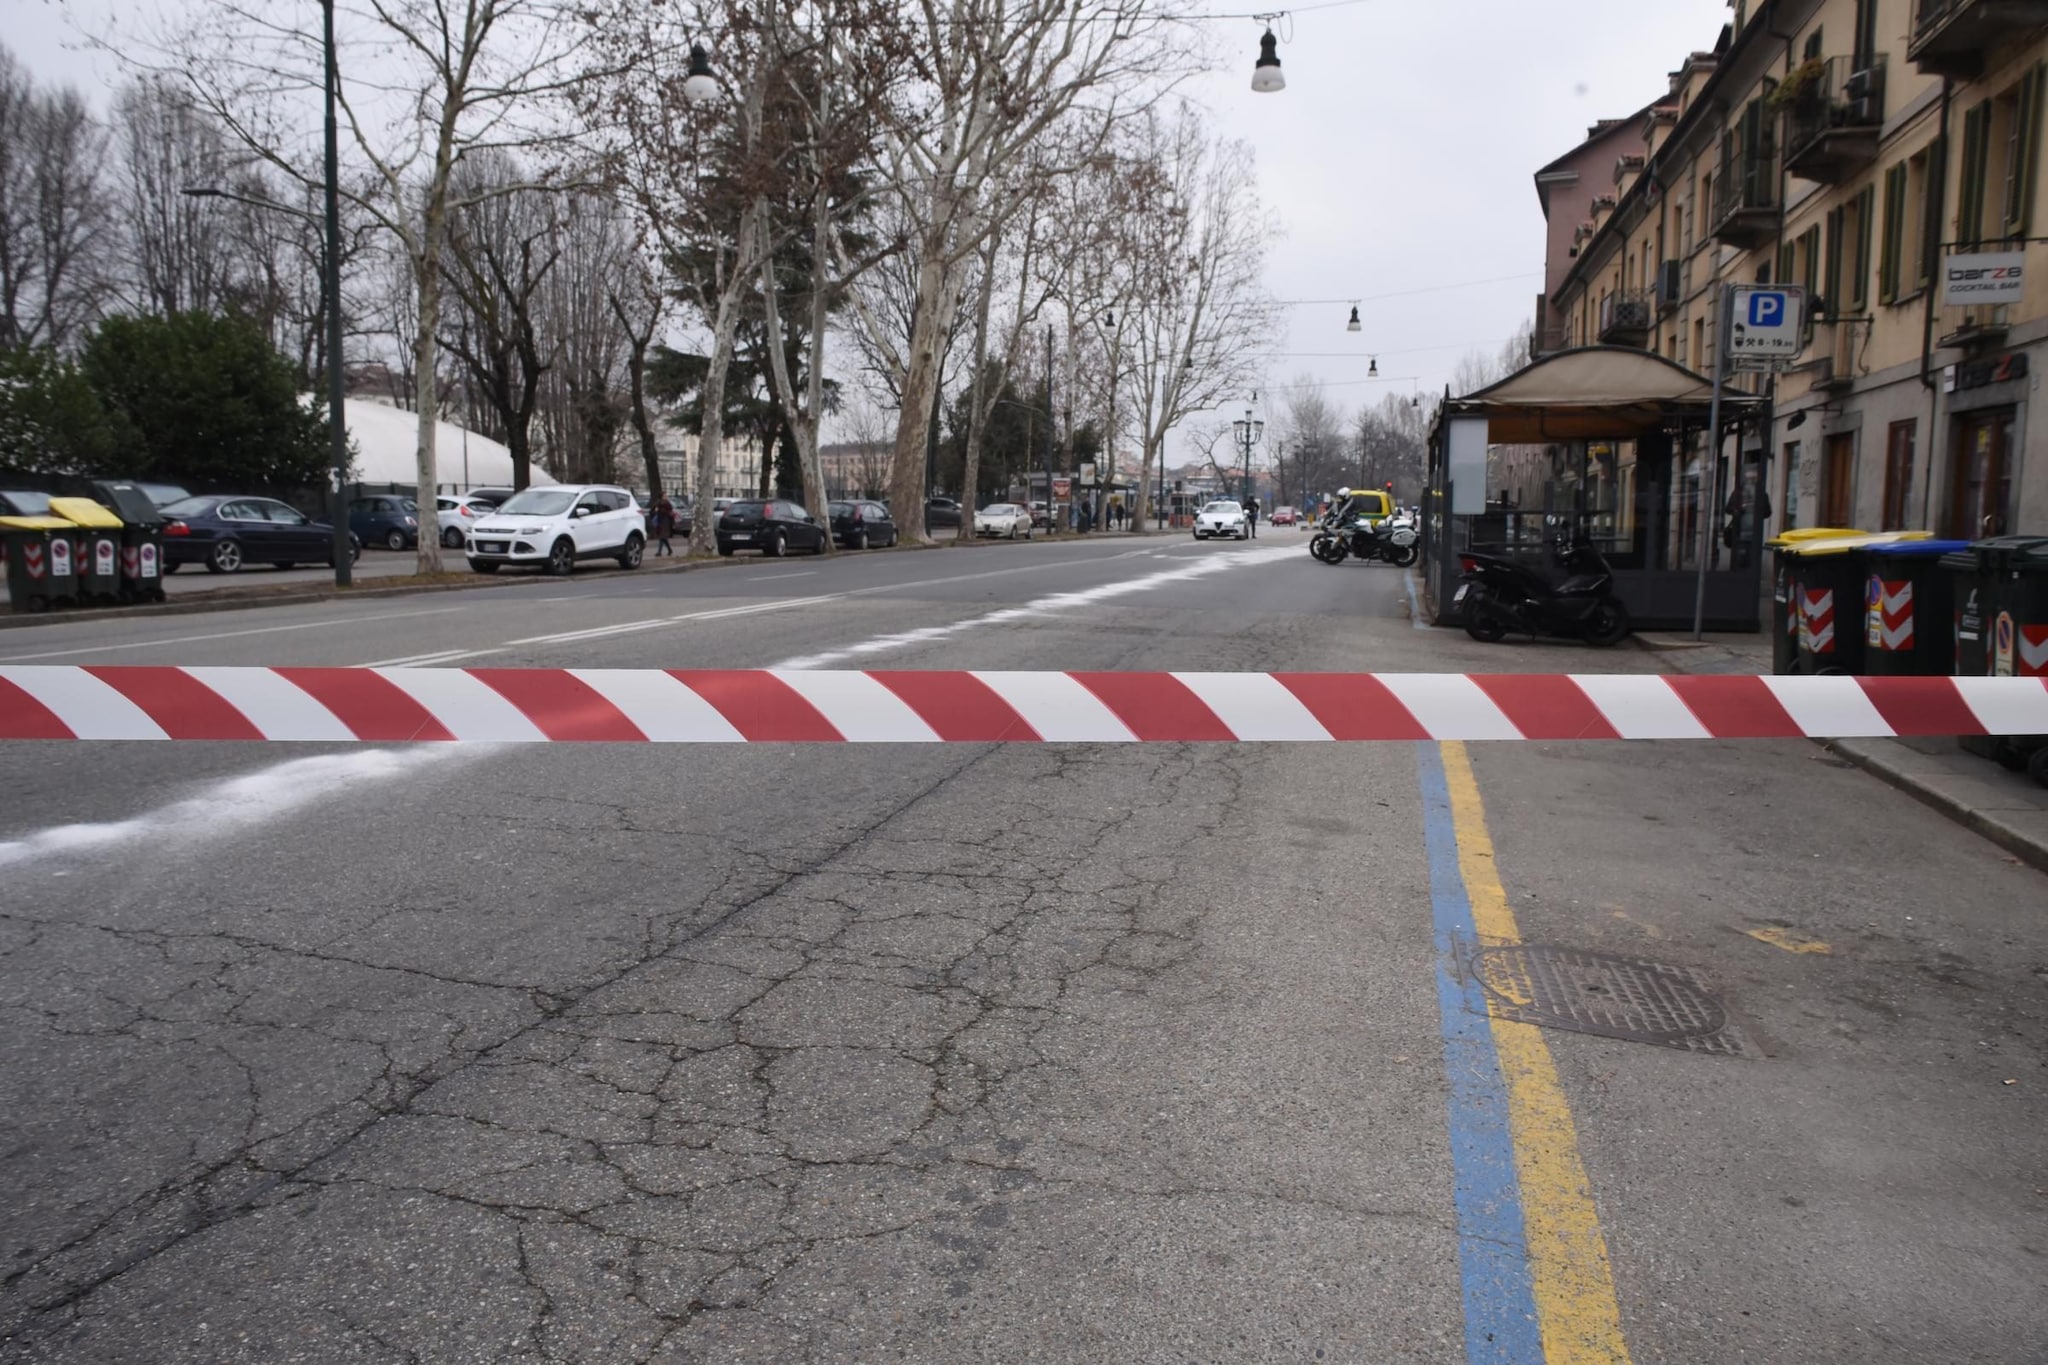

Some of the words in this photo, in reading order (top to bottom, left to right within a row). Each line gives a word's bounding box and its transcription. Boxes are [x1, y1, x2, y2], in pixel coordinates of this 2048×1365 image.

[1950, 284, 1996, 293] COCKTAIL
[1998, 281, 2020, 291] BAR
[1756, 296, 1778, 323] P
